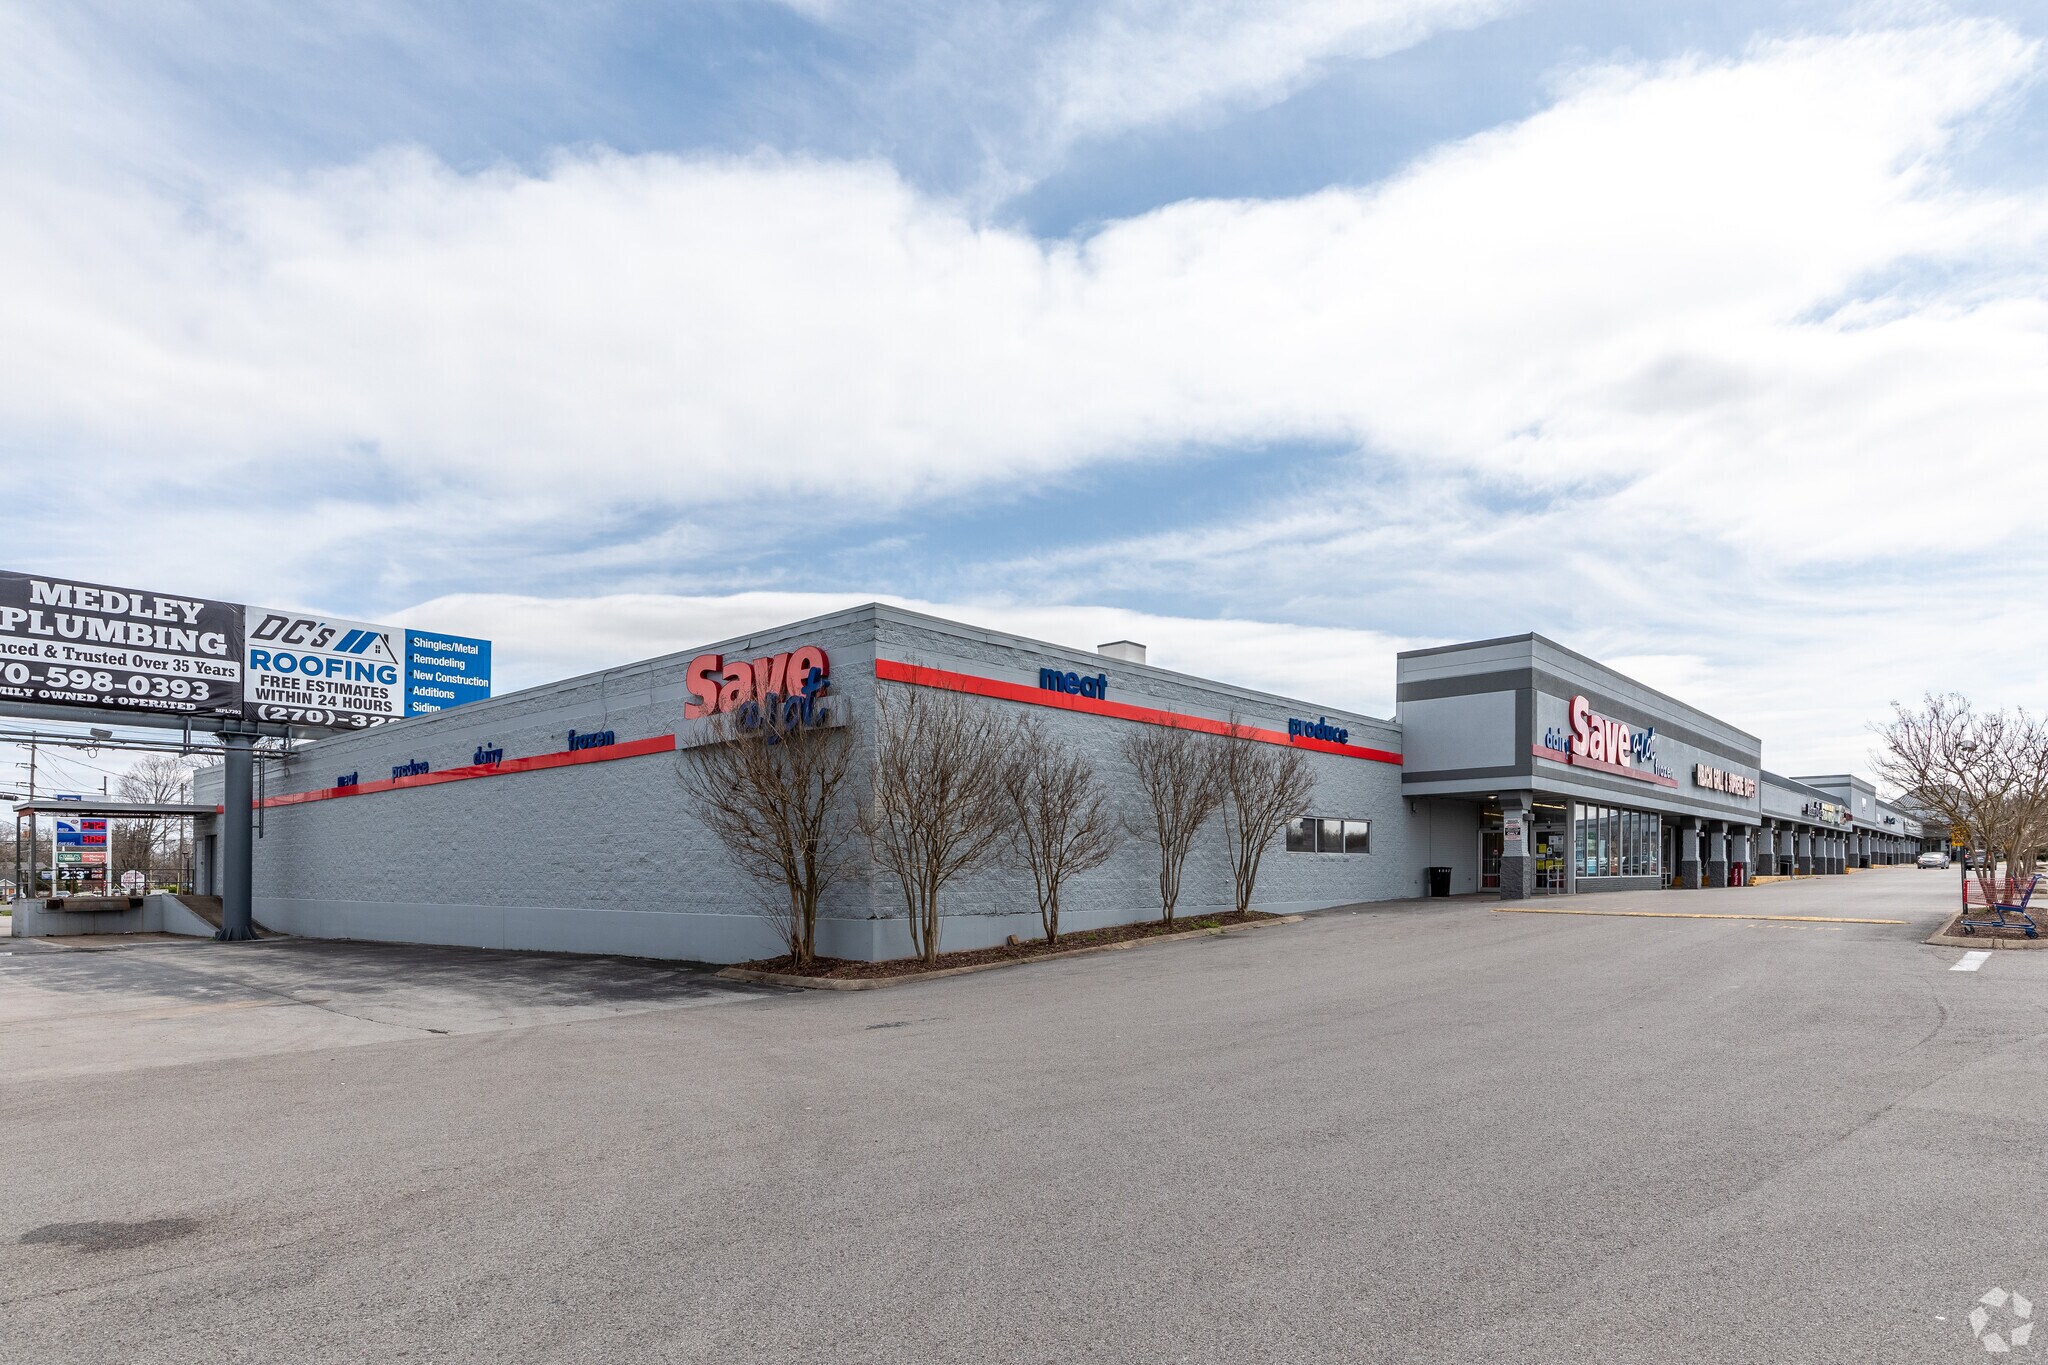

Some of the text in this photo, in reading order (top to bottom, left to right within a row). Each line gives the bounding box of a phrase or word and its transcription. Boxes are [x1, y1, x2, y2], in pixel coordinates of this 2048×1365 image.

[30, 580, 204, 624] MEDLEY
[0, 606, 228, 656] PLUMBING
[249, 614, 336, 648] DC's
[413, 637, 479, 655] Shingles/Metal
[44, 644, 58, 659] &
[63, 646, 127, 666] Trusted
[132, 654, 169, 671] Over
[172, 659, 190, 673] 35
[194, 661, 235, 678] Years
[249, 648, 398, 685] ROOFING
[413, 653, 466, 670] Remodeling
[0, 661, 210, 701] 0-598-0393
[260, 675, 389, 699] FREE ESTIMATES
[413, 670, 489, 688] New Construction
[413, 686, 455, 700] Additions
[684, 645, 830, 720] Save
[1039, 667, 1108, 700] meat
[38, 689, 98, 704] OWNED
[102, 695, 115, 704] &
[118, 697, 197, 711] OPERATED
[255, 688, 393, 713] WITHIN 24 HOURS
[567, 729, 615, 751] frozen
[1288, 716, 1349, 745] produce
[1569, 695, 1631, 767] Save
[391, 759, 430, 783] produce
